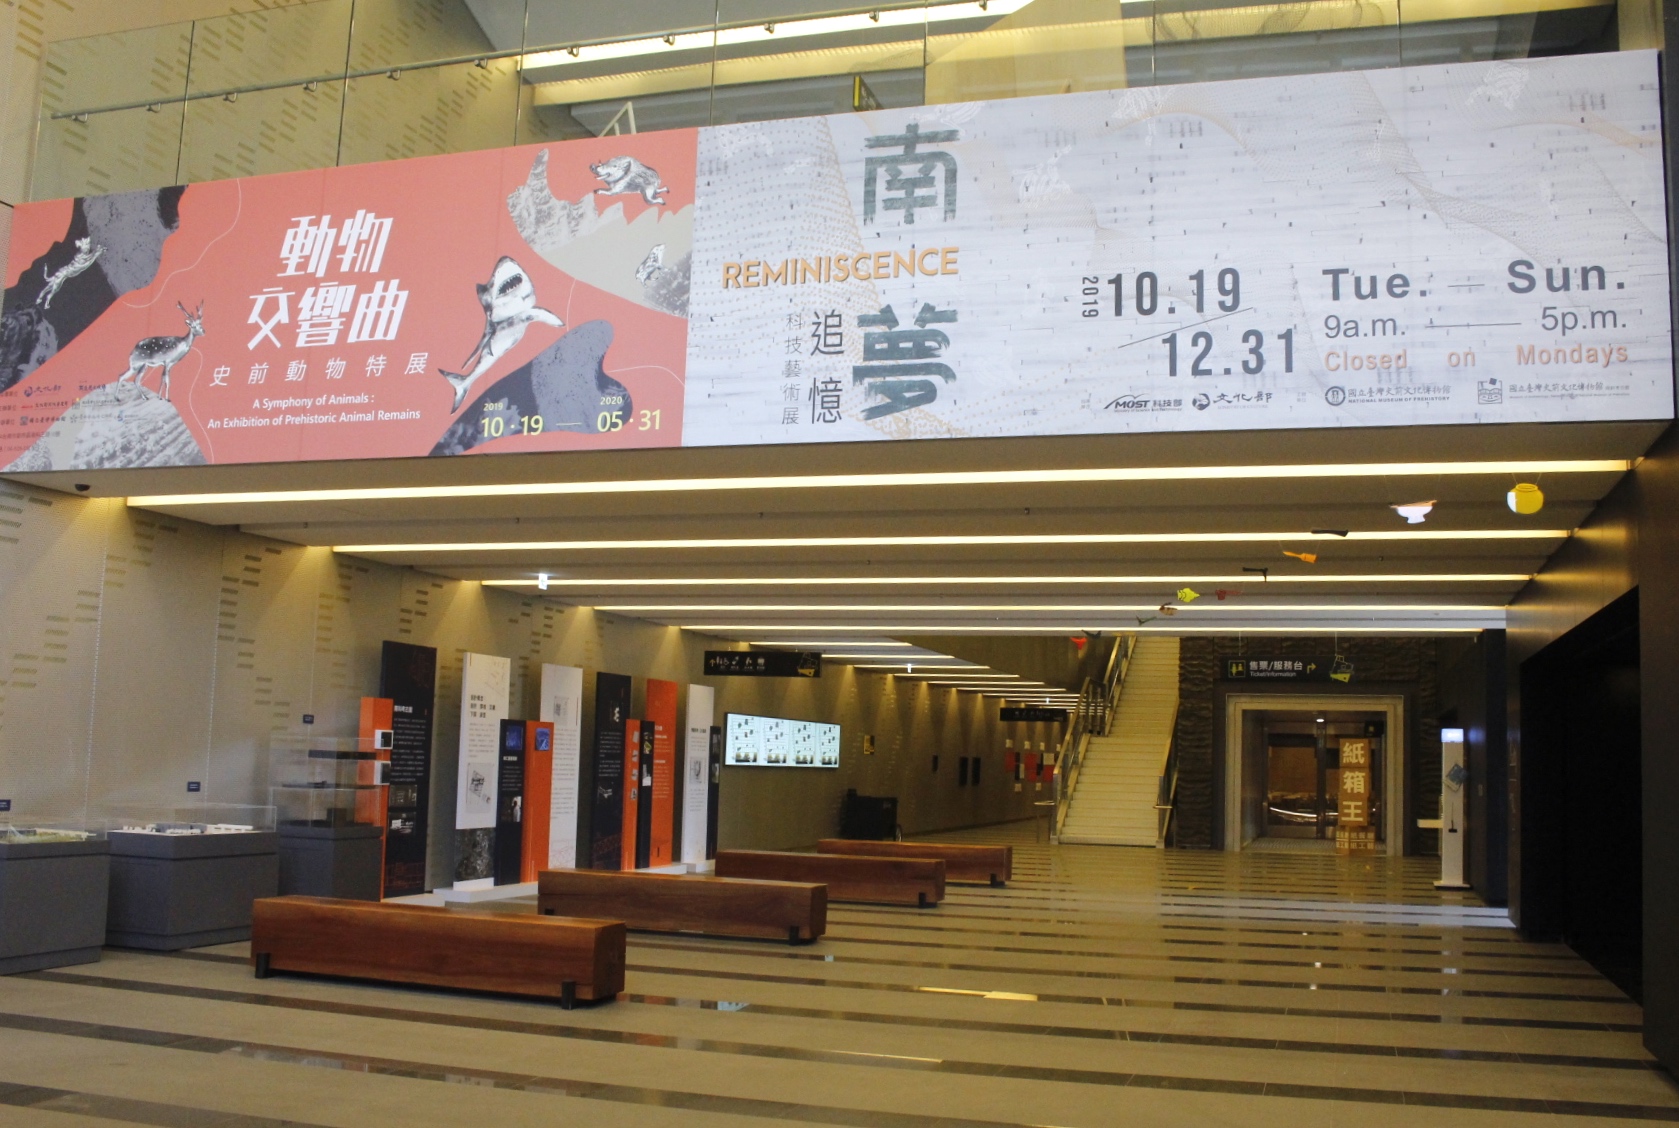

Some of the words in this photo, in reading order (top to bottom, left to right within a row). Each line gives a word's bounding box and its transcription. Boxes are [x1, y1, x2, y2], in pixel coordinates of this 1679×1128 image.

[863, 123, 960, 226] 南
[276, 209, 394, 277] 動物
[721, 247, 959, 289] REMINISCENCE
[1322, 268, 1428, 301] Tue.
[1507, 259, 1626, 294] Sun.
[1082, 276, 1099, 319] 2019
[1107, 267, 1241, 317] 10.19
[247, 279, 410, 351] 交響曲
[1323, 314, 1407, 339] 9a.m.
[1541, 305, 1628, 336] 5p.m.
[209, 352, 429, 387] 史前動物特展
[808, 308, 845, 425] 追憶
[1162, 328, 1294, 377] 12.31
[1324, 349, 1408, 371] Closed
[1447, 350, 1476, 368] on
[1516, 343, 1629, 368] Mondays
[207, 418, 220, 428] An
[223, 416, 270, 428] Exhibition
[272, 414, 283, 425] of
[285, 412, 336, 424] Prehistoric
[339, 410, 375, 422] Animal
[377, 409, 421, 421] Remains
[253, 399, 260, 409] A
[263, 396, 313, 410] Symphony
[315, 395, 327, 405] of
[483, 402, 504, 412] 2019
[600, 396, 622, 406] 2020
[1114, 400, 1150, 409] MOST
[1213, 392, 1273, 404] 文化部
[1342, 742, 1366, 822] 紙箱王
